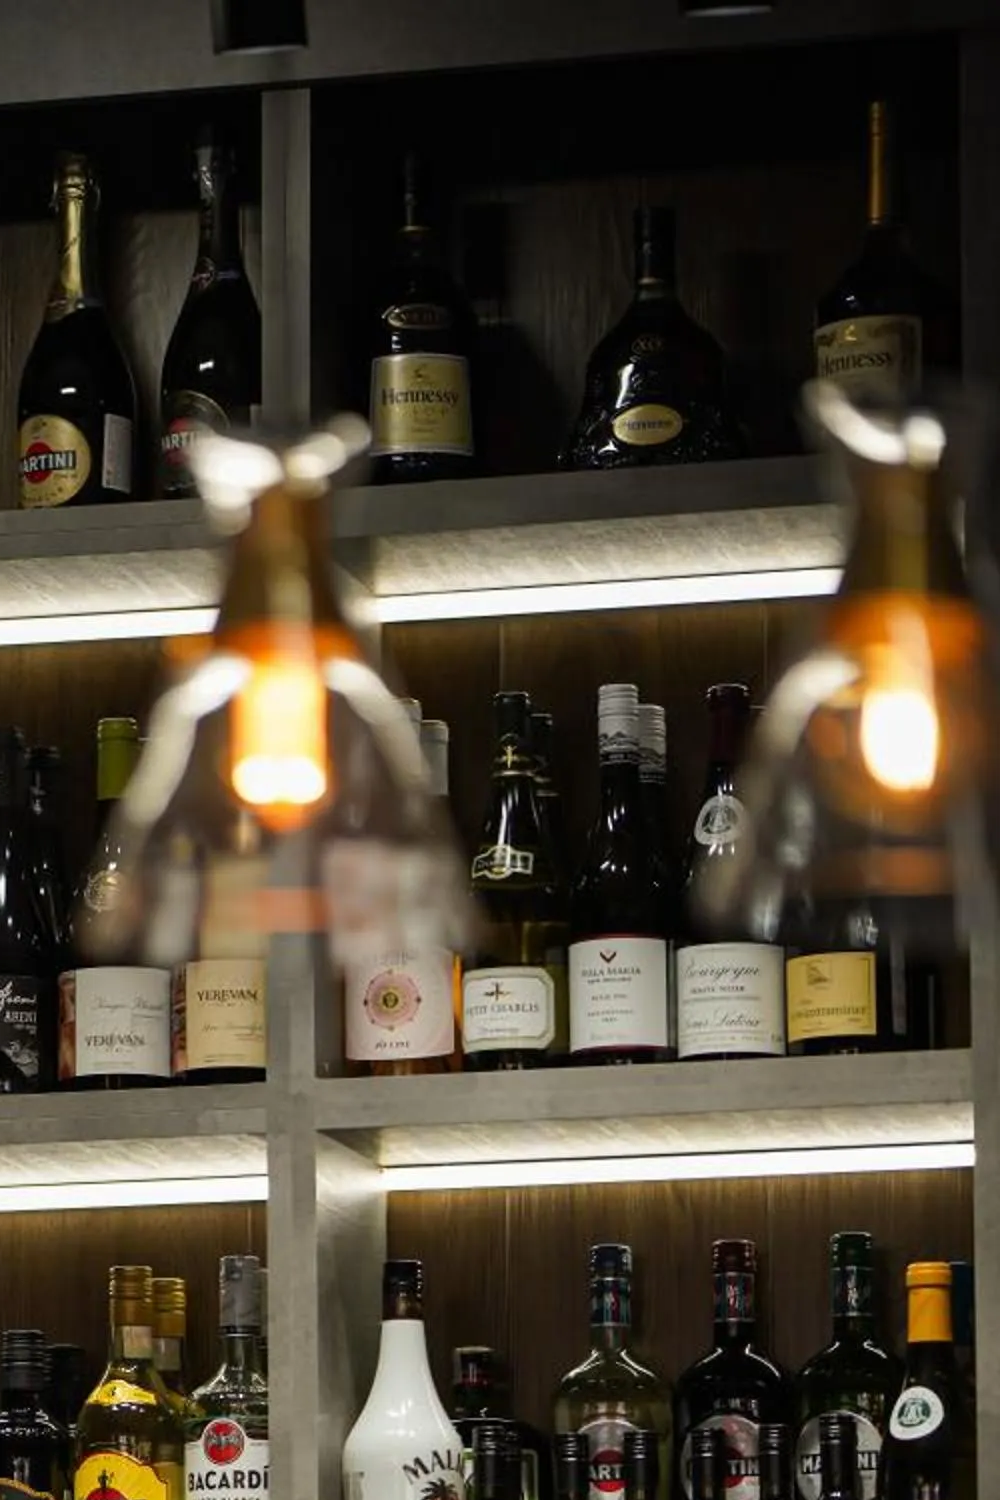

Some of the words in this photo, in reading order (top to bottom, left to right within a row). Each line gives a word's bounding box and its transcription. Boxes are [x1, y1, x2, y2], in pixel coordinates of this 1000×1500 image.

[381, 387, 459, 407] Hennessy
[160, 430, 198, 451] ARTI
[196, 989, 260, 1002] YEREVAN
